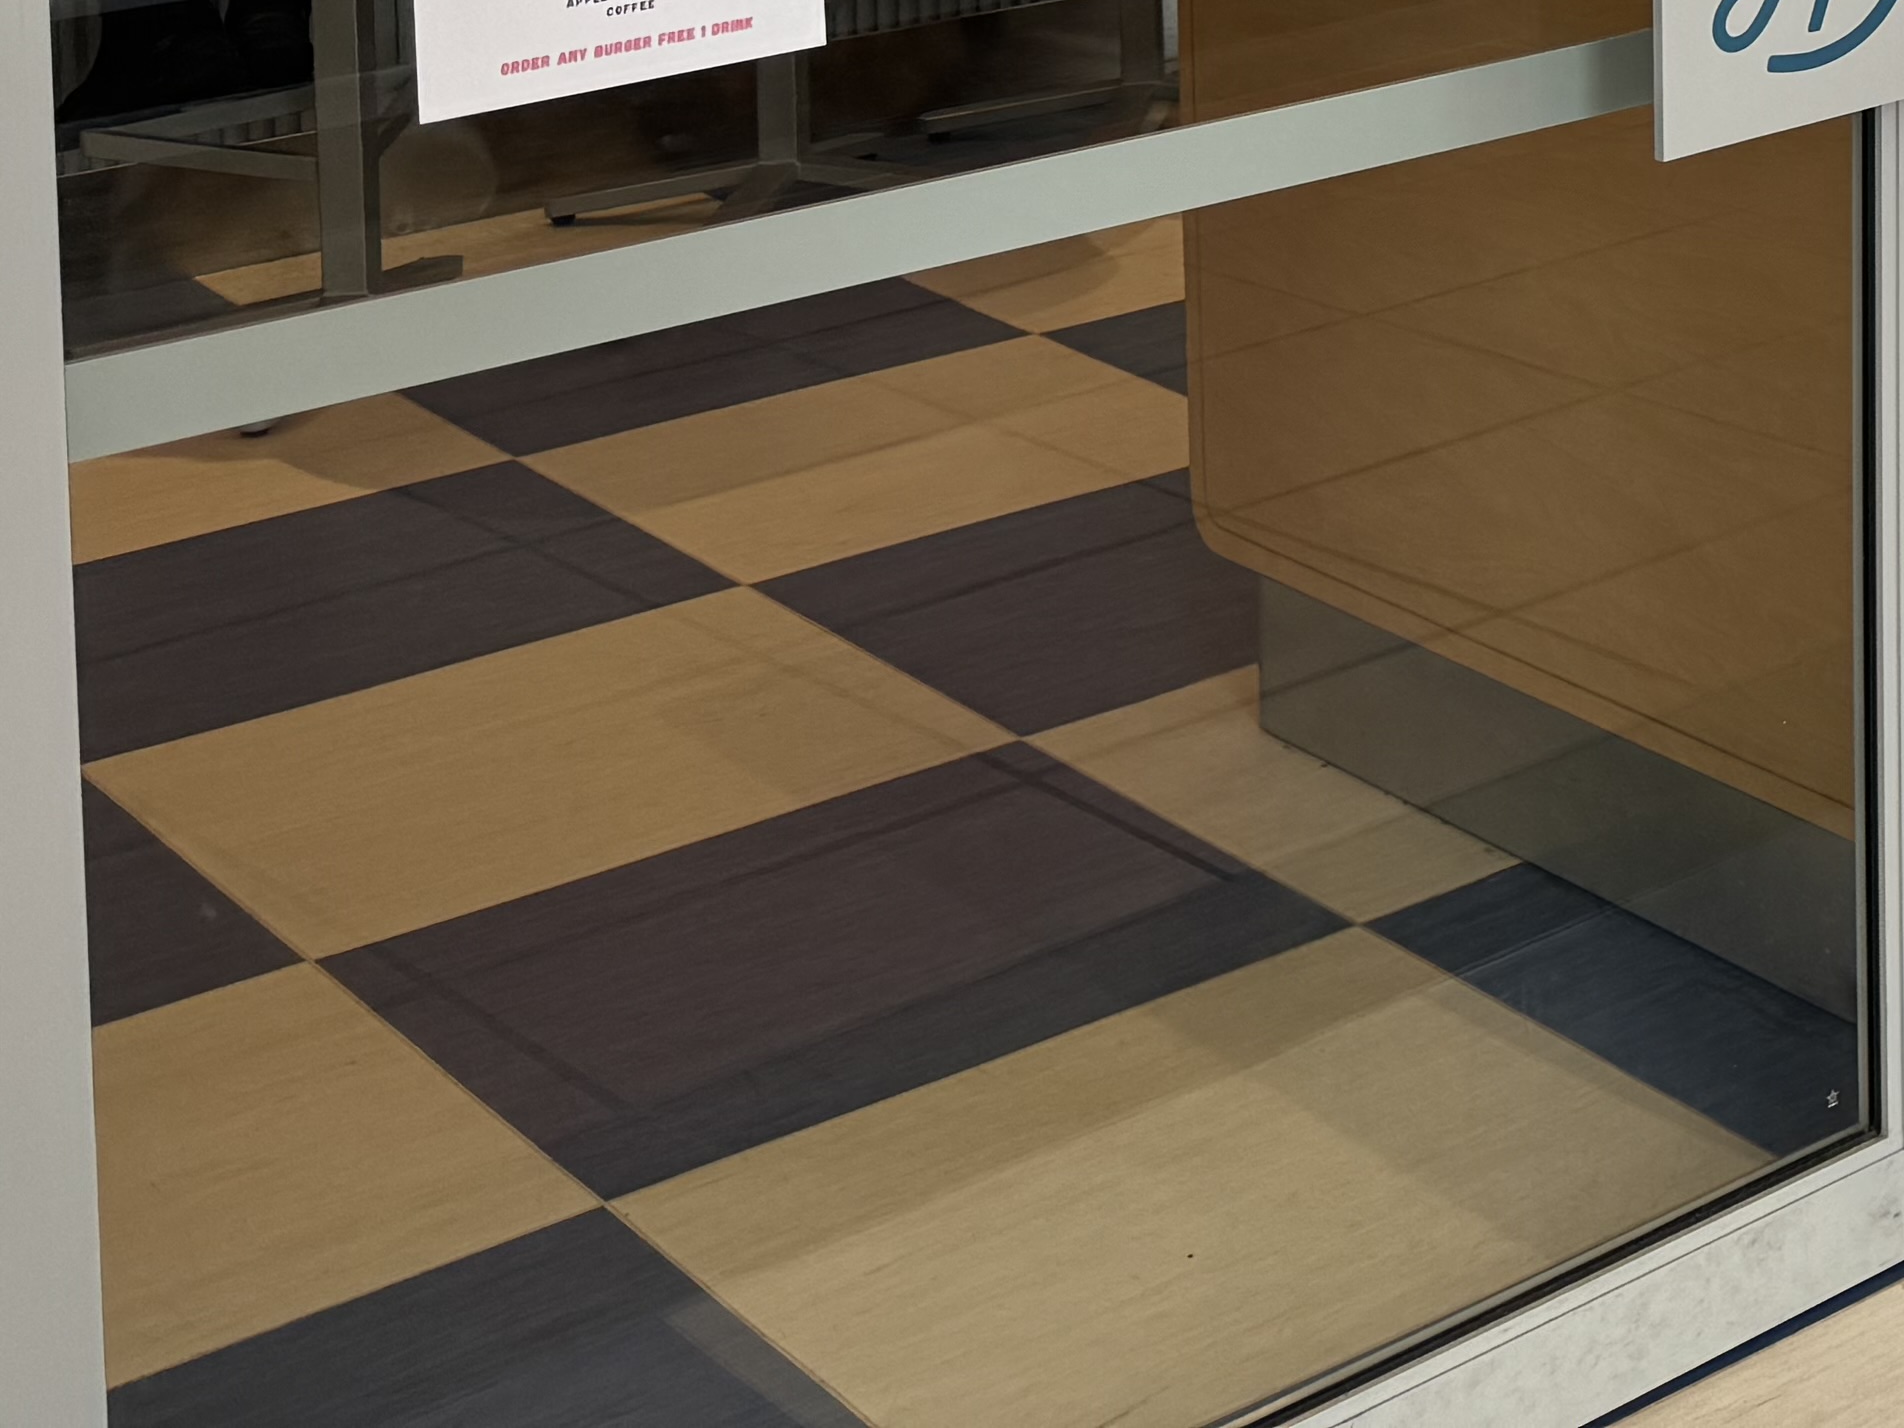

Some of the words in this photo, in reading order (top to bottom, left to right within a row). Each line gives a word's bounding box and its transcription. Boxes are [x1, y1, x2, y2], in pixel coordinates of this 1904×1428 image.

[606, 0, 655, 17] COFFEE
[500, 55, 550, 76] ORDER
[557, 48, 588, 66] ANY
[594, 36, 652, 58] BURGER
[658, 27, 696, 47] FREE
[711, 16, 753, 36] DRINK
